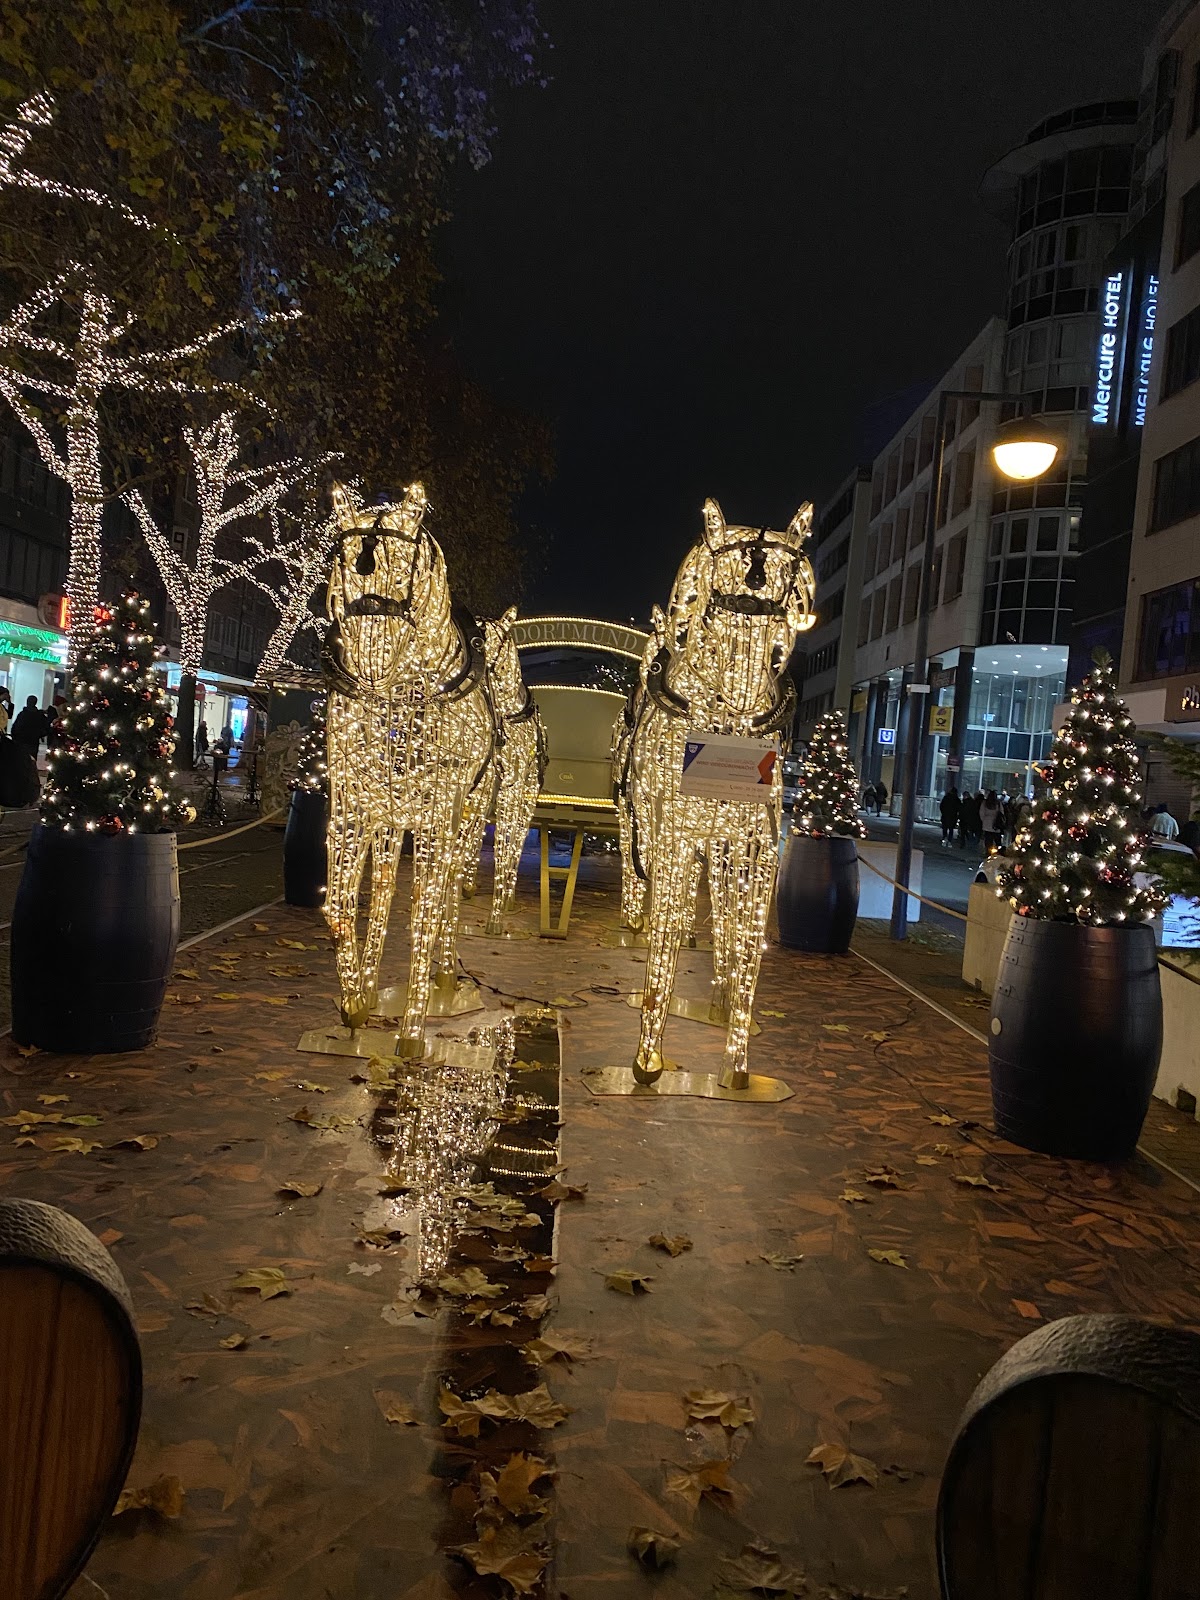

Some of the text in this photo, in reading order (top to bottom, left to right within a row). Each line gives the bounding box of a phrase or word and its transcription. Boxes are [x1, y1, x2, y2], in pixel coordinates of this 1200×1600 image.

[1092, 272, 1123, 423] Mercure HOTEL
[512, 622, 638, 651] DORTMUND
